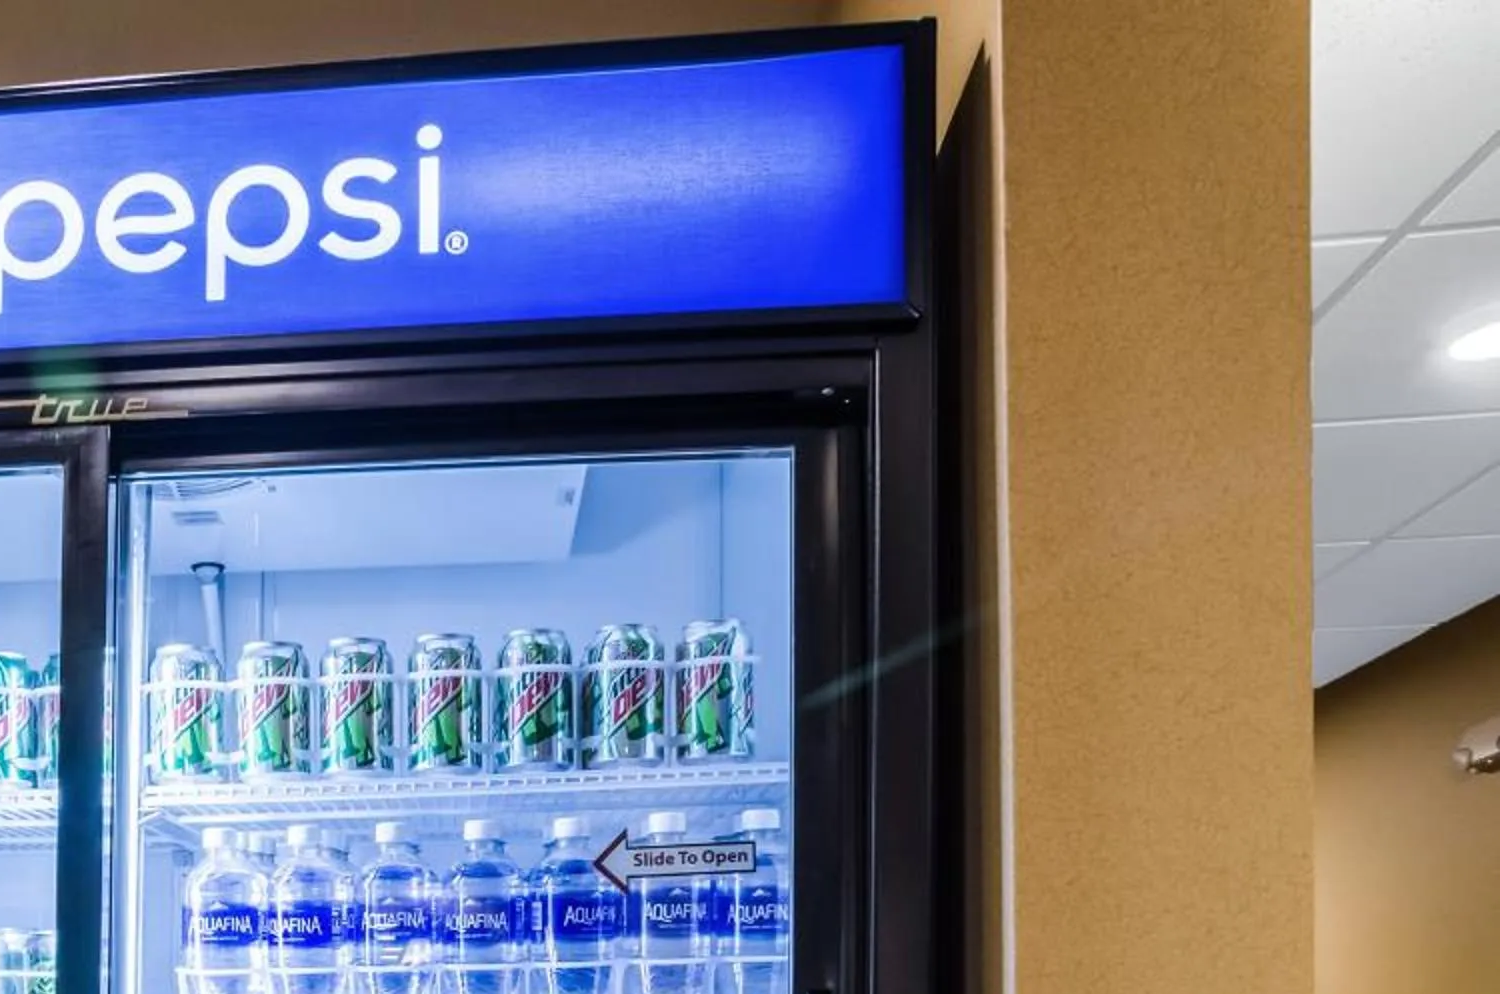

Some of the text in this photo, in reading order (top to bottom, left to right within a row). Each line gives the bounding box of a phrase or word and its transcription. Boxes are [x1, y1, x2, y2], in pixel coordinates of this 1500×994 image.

[633, 850, 748, 867] Slide To Open
